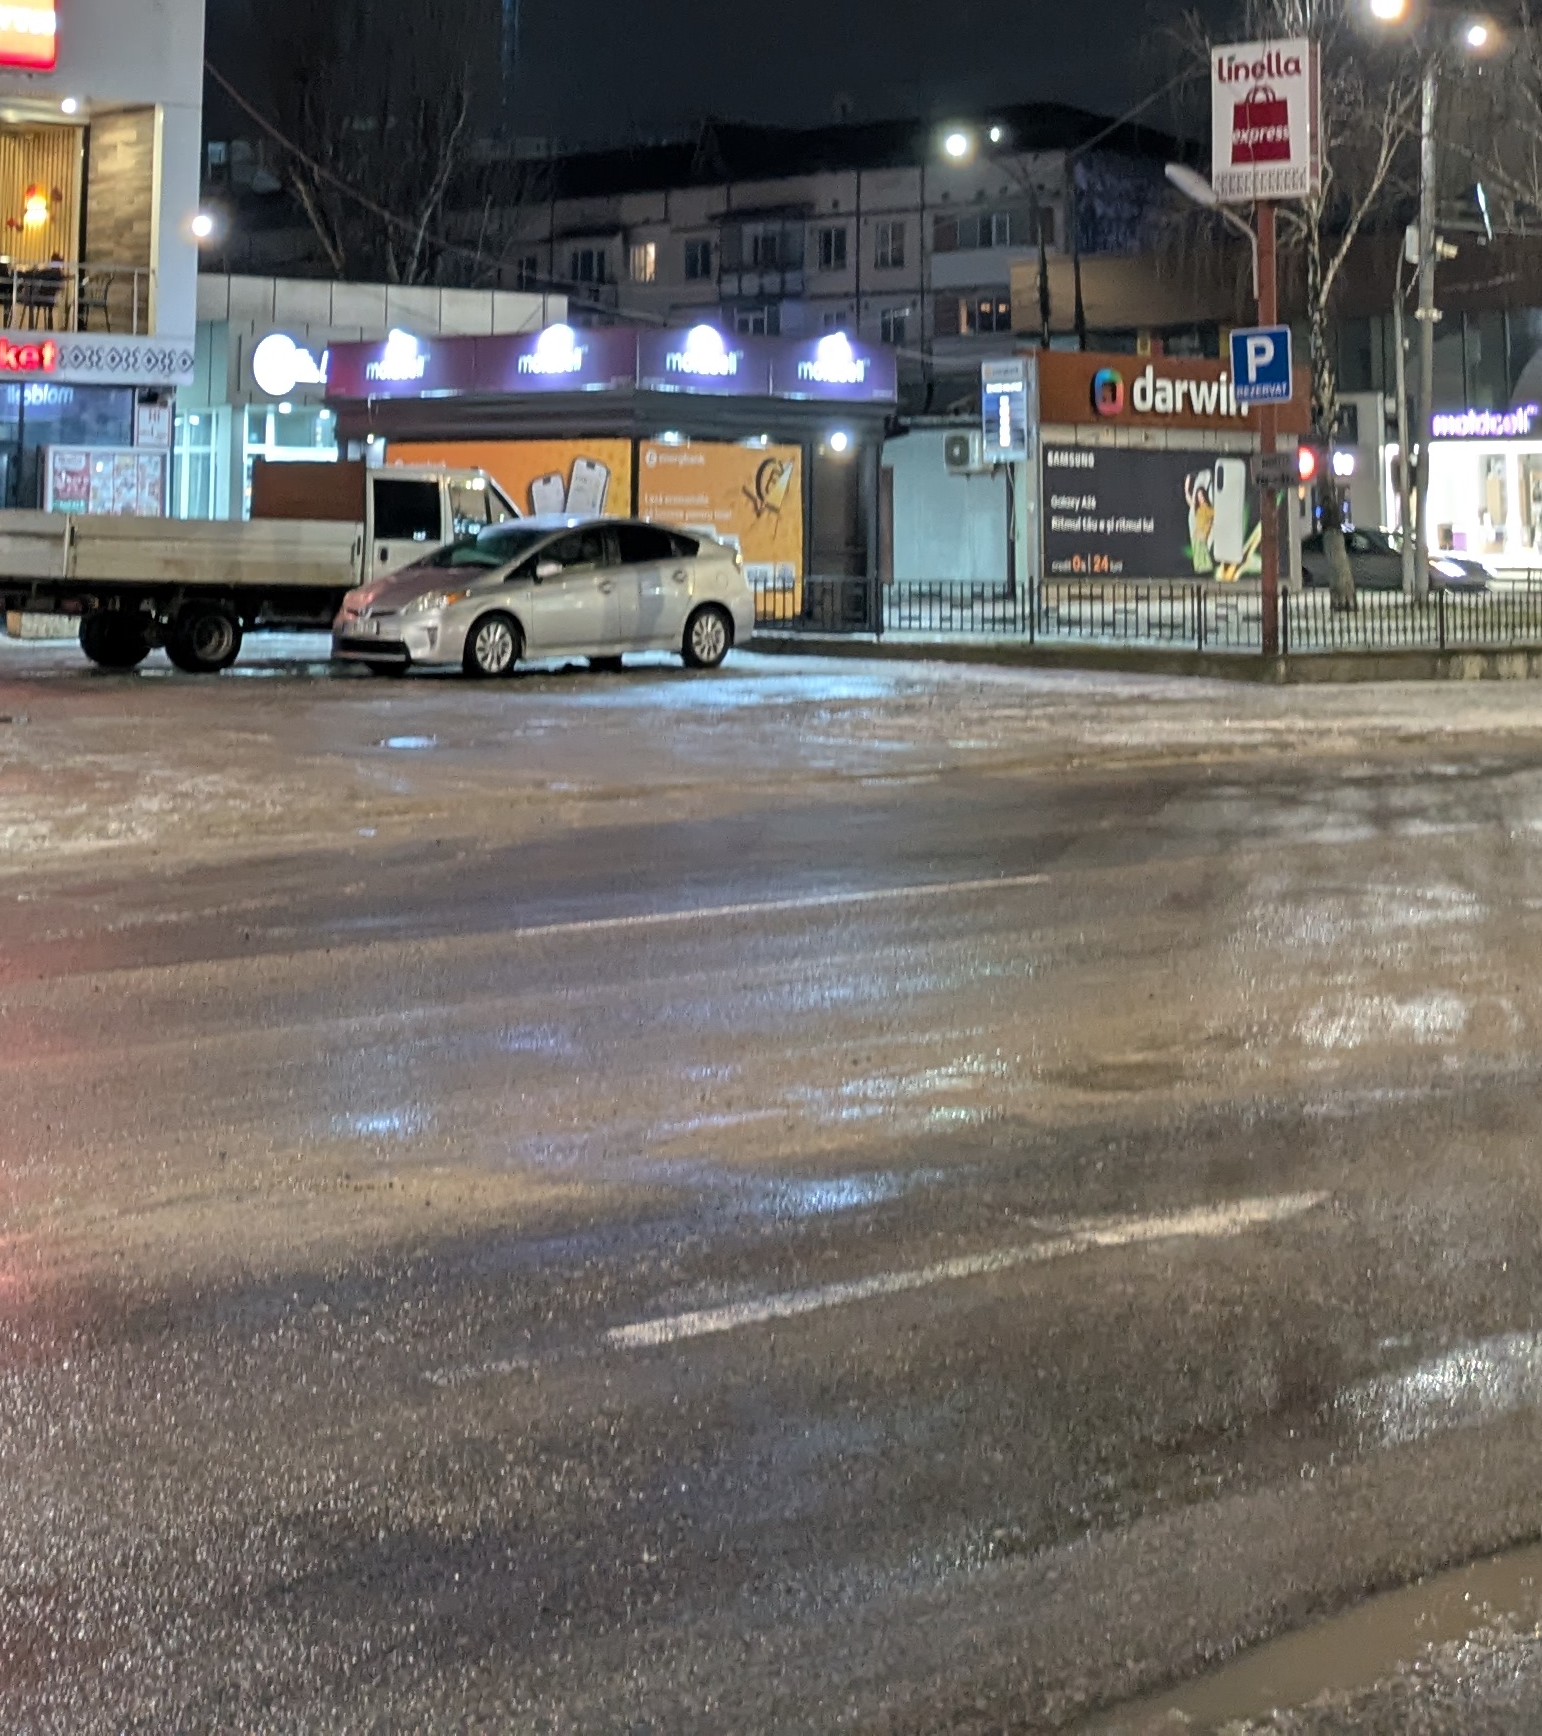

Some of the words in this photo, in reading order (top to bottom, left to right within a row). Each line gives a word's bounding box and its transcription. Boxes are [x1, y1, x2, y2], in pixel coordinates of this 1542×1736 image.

[1217, 50, 1302, 83] linella
[1232, 124, 1290, 146] express
[1132, 363, 1249, 417] darwin
[1046, 450, 1095, 469] SAMSUNG
